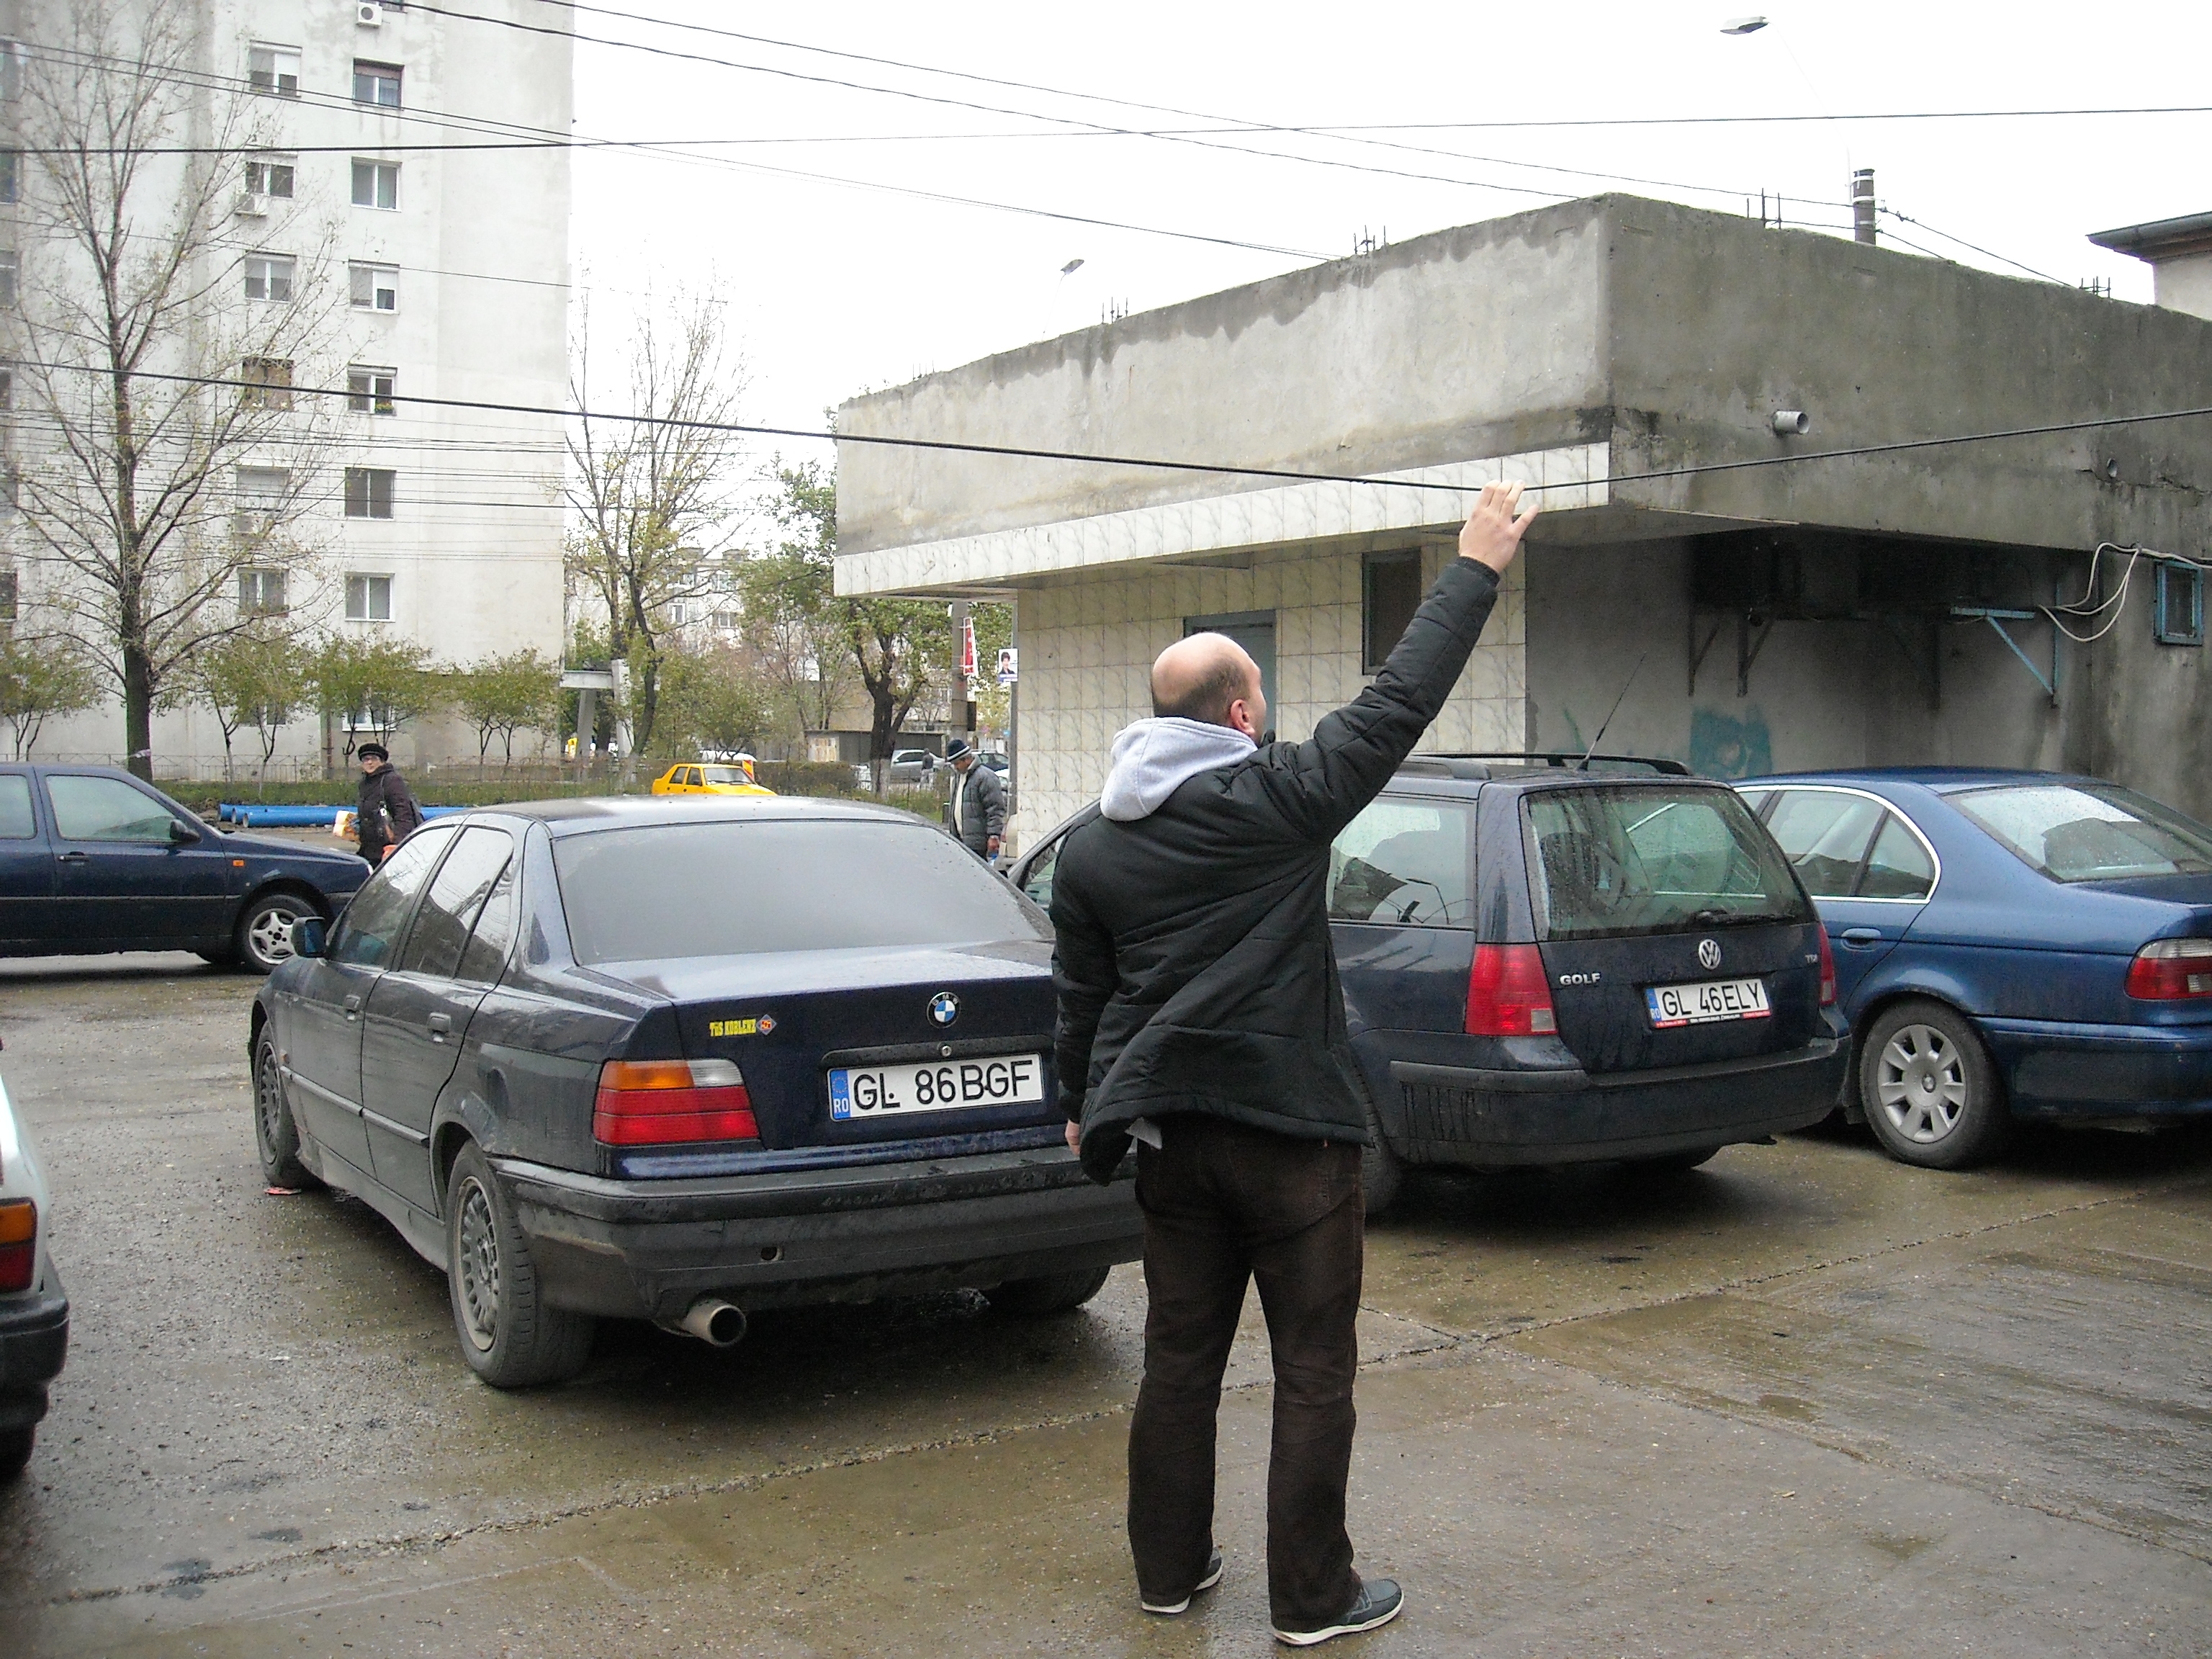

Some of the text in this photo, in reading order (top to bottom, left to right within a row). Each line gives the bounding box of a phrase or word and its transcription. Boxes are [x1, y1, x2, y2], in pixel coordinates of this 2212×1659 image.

[1560, 972, 1601, 986] GOLF
[931, 994, 958, 1006] BMW
[1662, 983, 1760, 1016] GL 46ELY
[1651, 1008, 1661, 1020] RO
[853, 1059, 1033, 1110] GL 86BGF
[834, 1097, 850, 1114] RO
